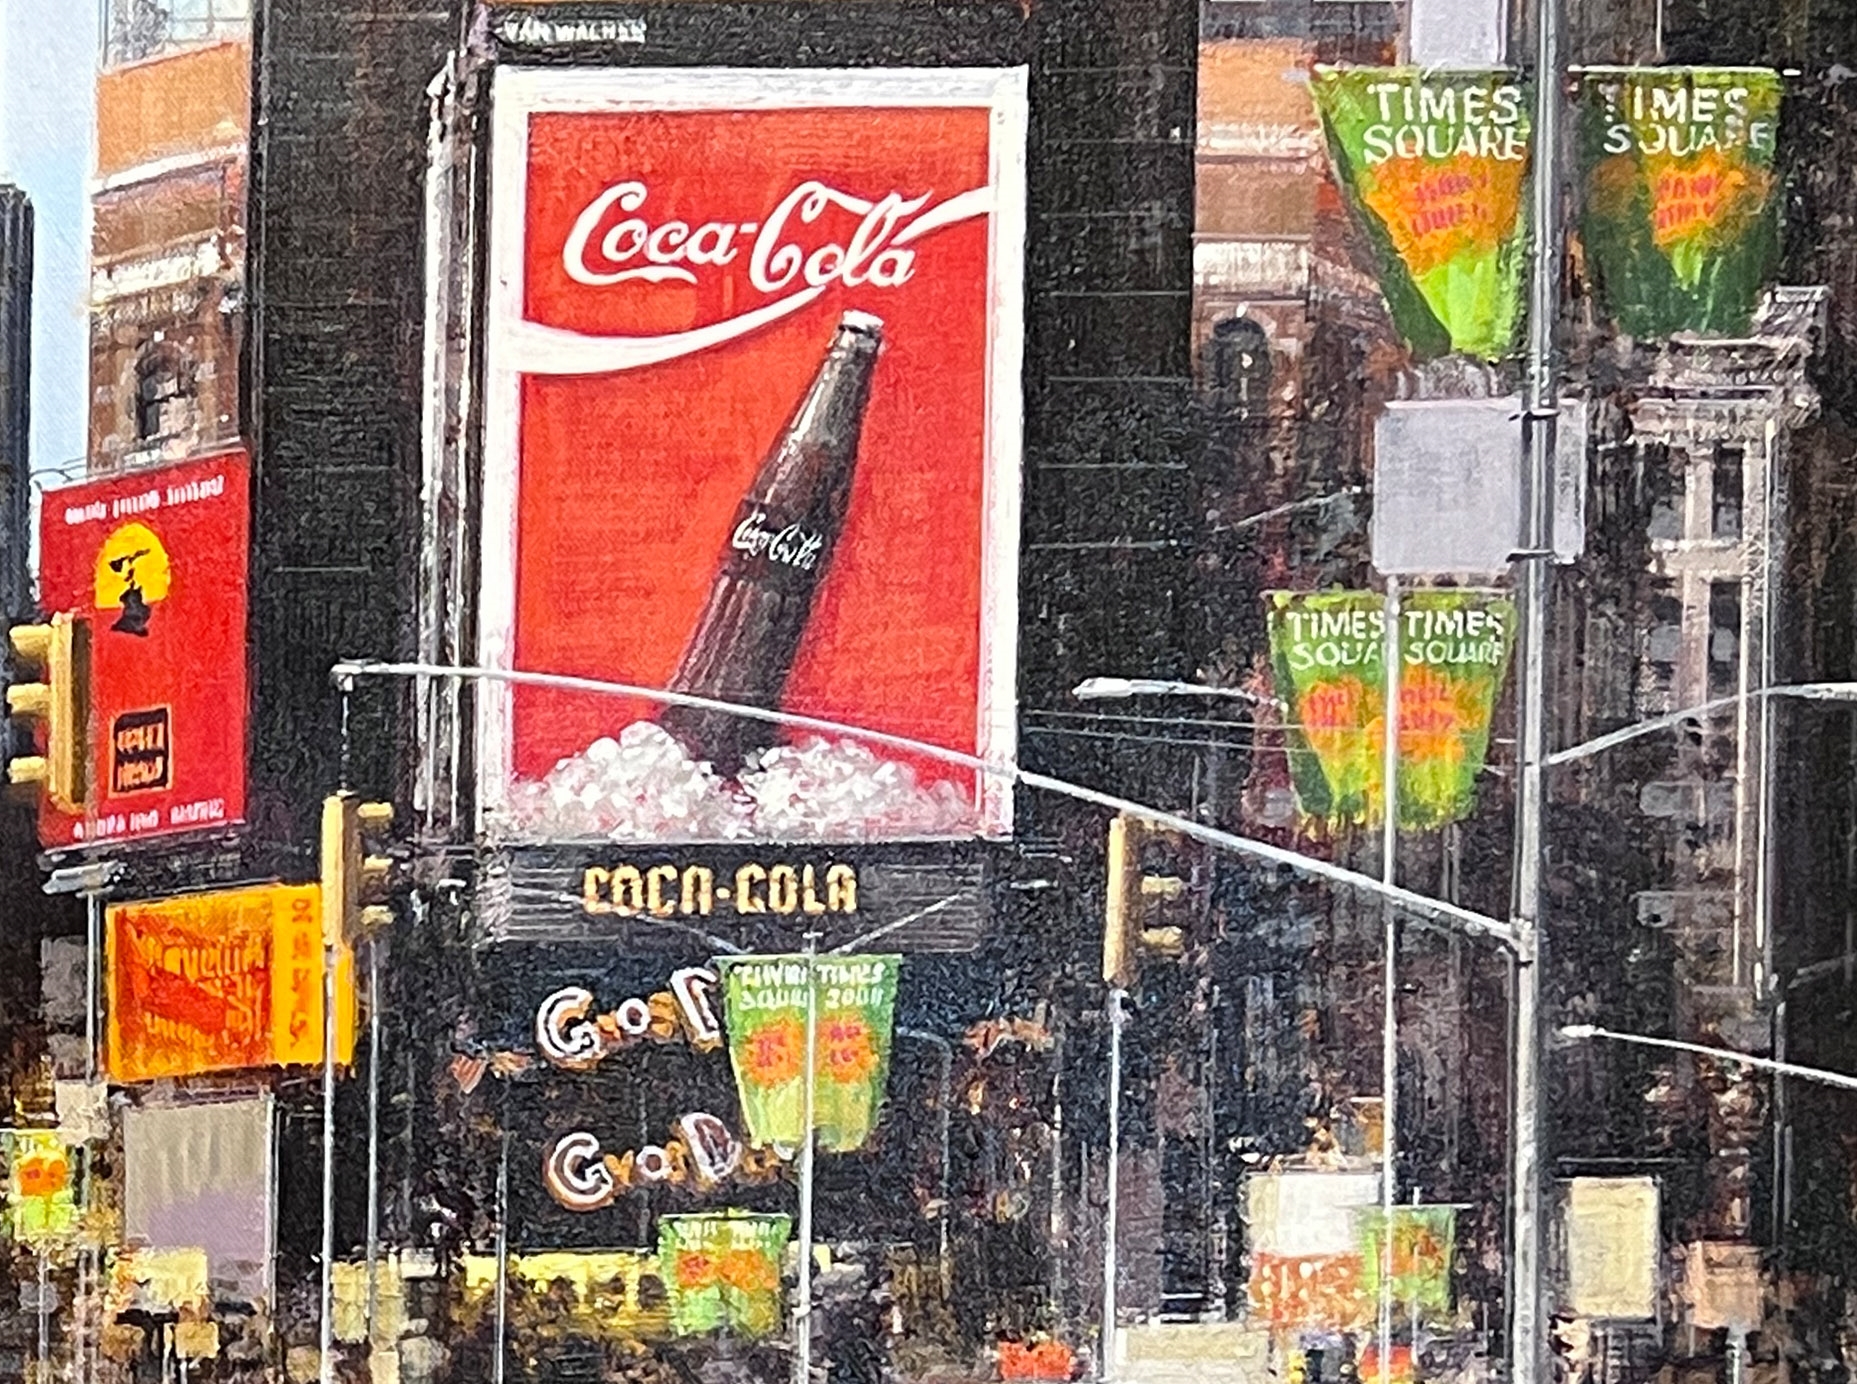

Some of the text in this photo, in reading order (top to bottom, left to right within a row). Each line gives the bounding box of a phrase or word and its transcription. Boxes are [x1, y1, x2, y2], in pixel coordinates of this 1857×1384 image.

[1366, 83, 1522, 125] TIMES
[1363, 124, 1532, 165] SQUARE
[562, 180, 934, 293] Coca-Cola
[1286, 610, 1386, 642] TIMES
[1404, 609, 1505, 641] TIMES
[583, 863, 858, 916] COCA-COLA
